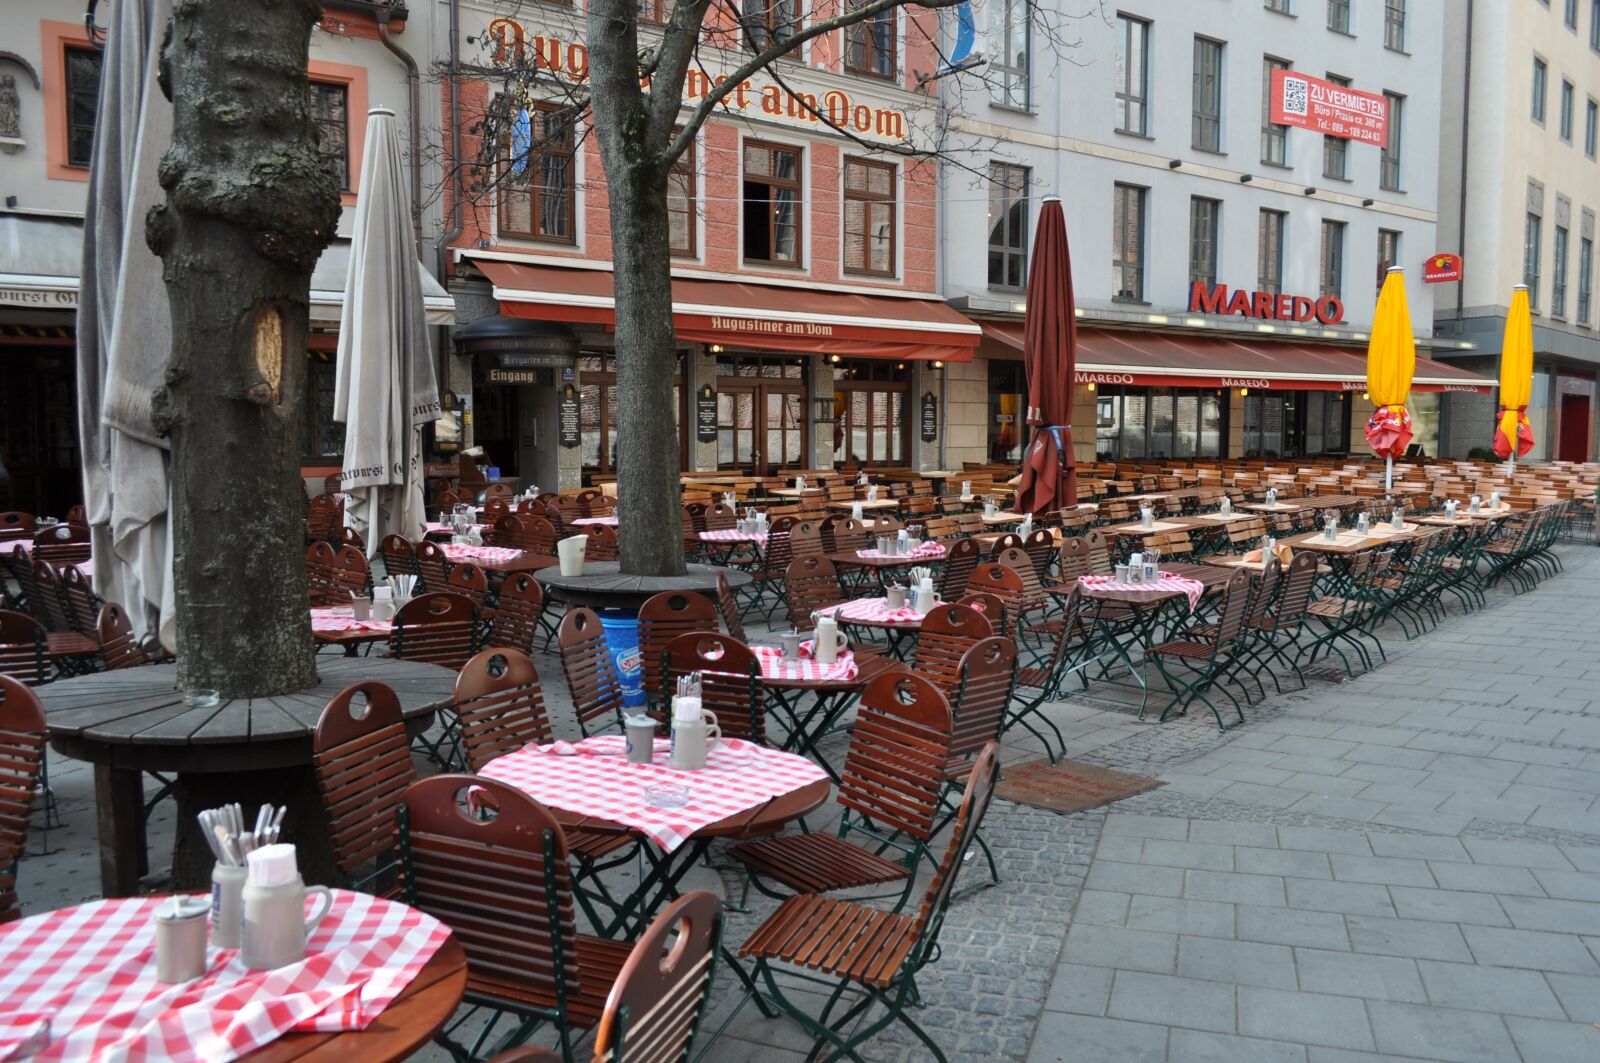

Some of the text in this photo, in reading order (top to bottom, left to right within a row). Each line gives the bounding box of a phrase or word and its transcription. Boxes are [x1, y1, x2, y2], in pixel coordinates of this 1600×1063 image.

[1310, 84, 1325, 100] ZU
[760, 83, 819, 123] am
[824, 89, 905, 140] Dom
[1314, 104, 1331, 116] Büro
[1335, 110, 1354, 123] Praxis
[1426, 271, 1457, 279] MAREDO
[1188, 280, 1345, 325] MAREDO
[711, 316, 833, 336] Augustiner am Dom
[490, 369, 534, 383] Eingang
[1074, 372, 1134, 384] MAREDO
[1221, 377, 1270, 388] MAREDO
